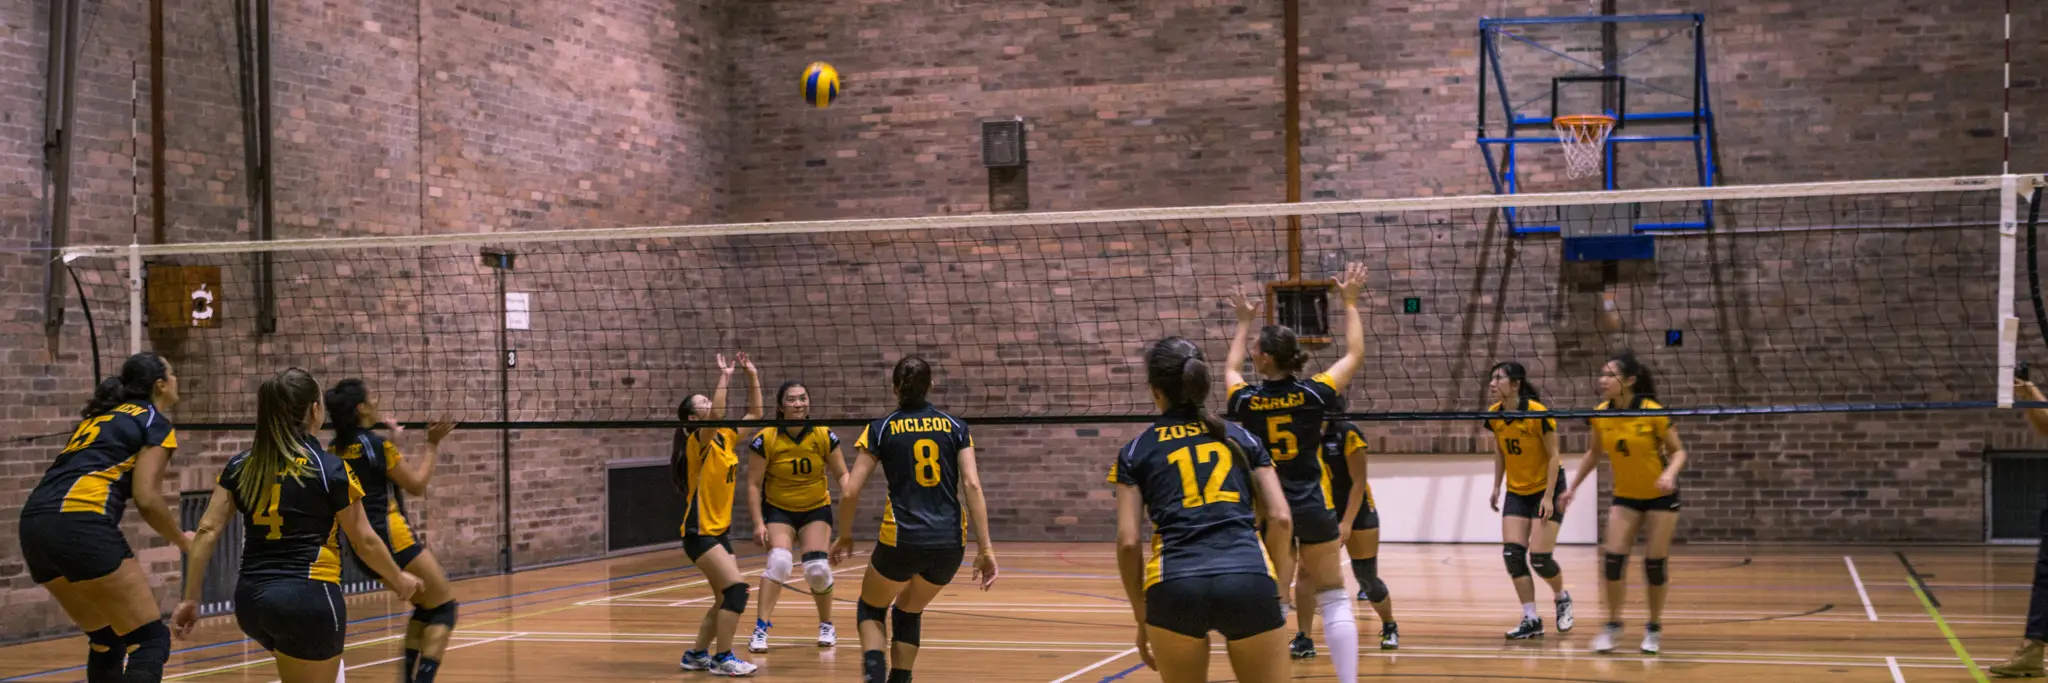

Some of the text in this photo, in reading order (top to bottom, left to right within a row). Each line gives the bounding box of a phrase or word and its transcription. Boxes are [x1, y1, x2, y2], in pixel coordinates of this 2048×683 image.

[889, 417, 952, 435] MCLEOD
[1265, 414, 1299, 461] 5
[913, 438, 941, 488] 8
[1505, 438, 1522, 455] 16
[1614, 438, 1631, 457] 4
[790, 457, 812, 475] 10
[1166, 441, 1241, 509] 12
[252, 483, 284, 540] 4
